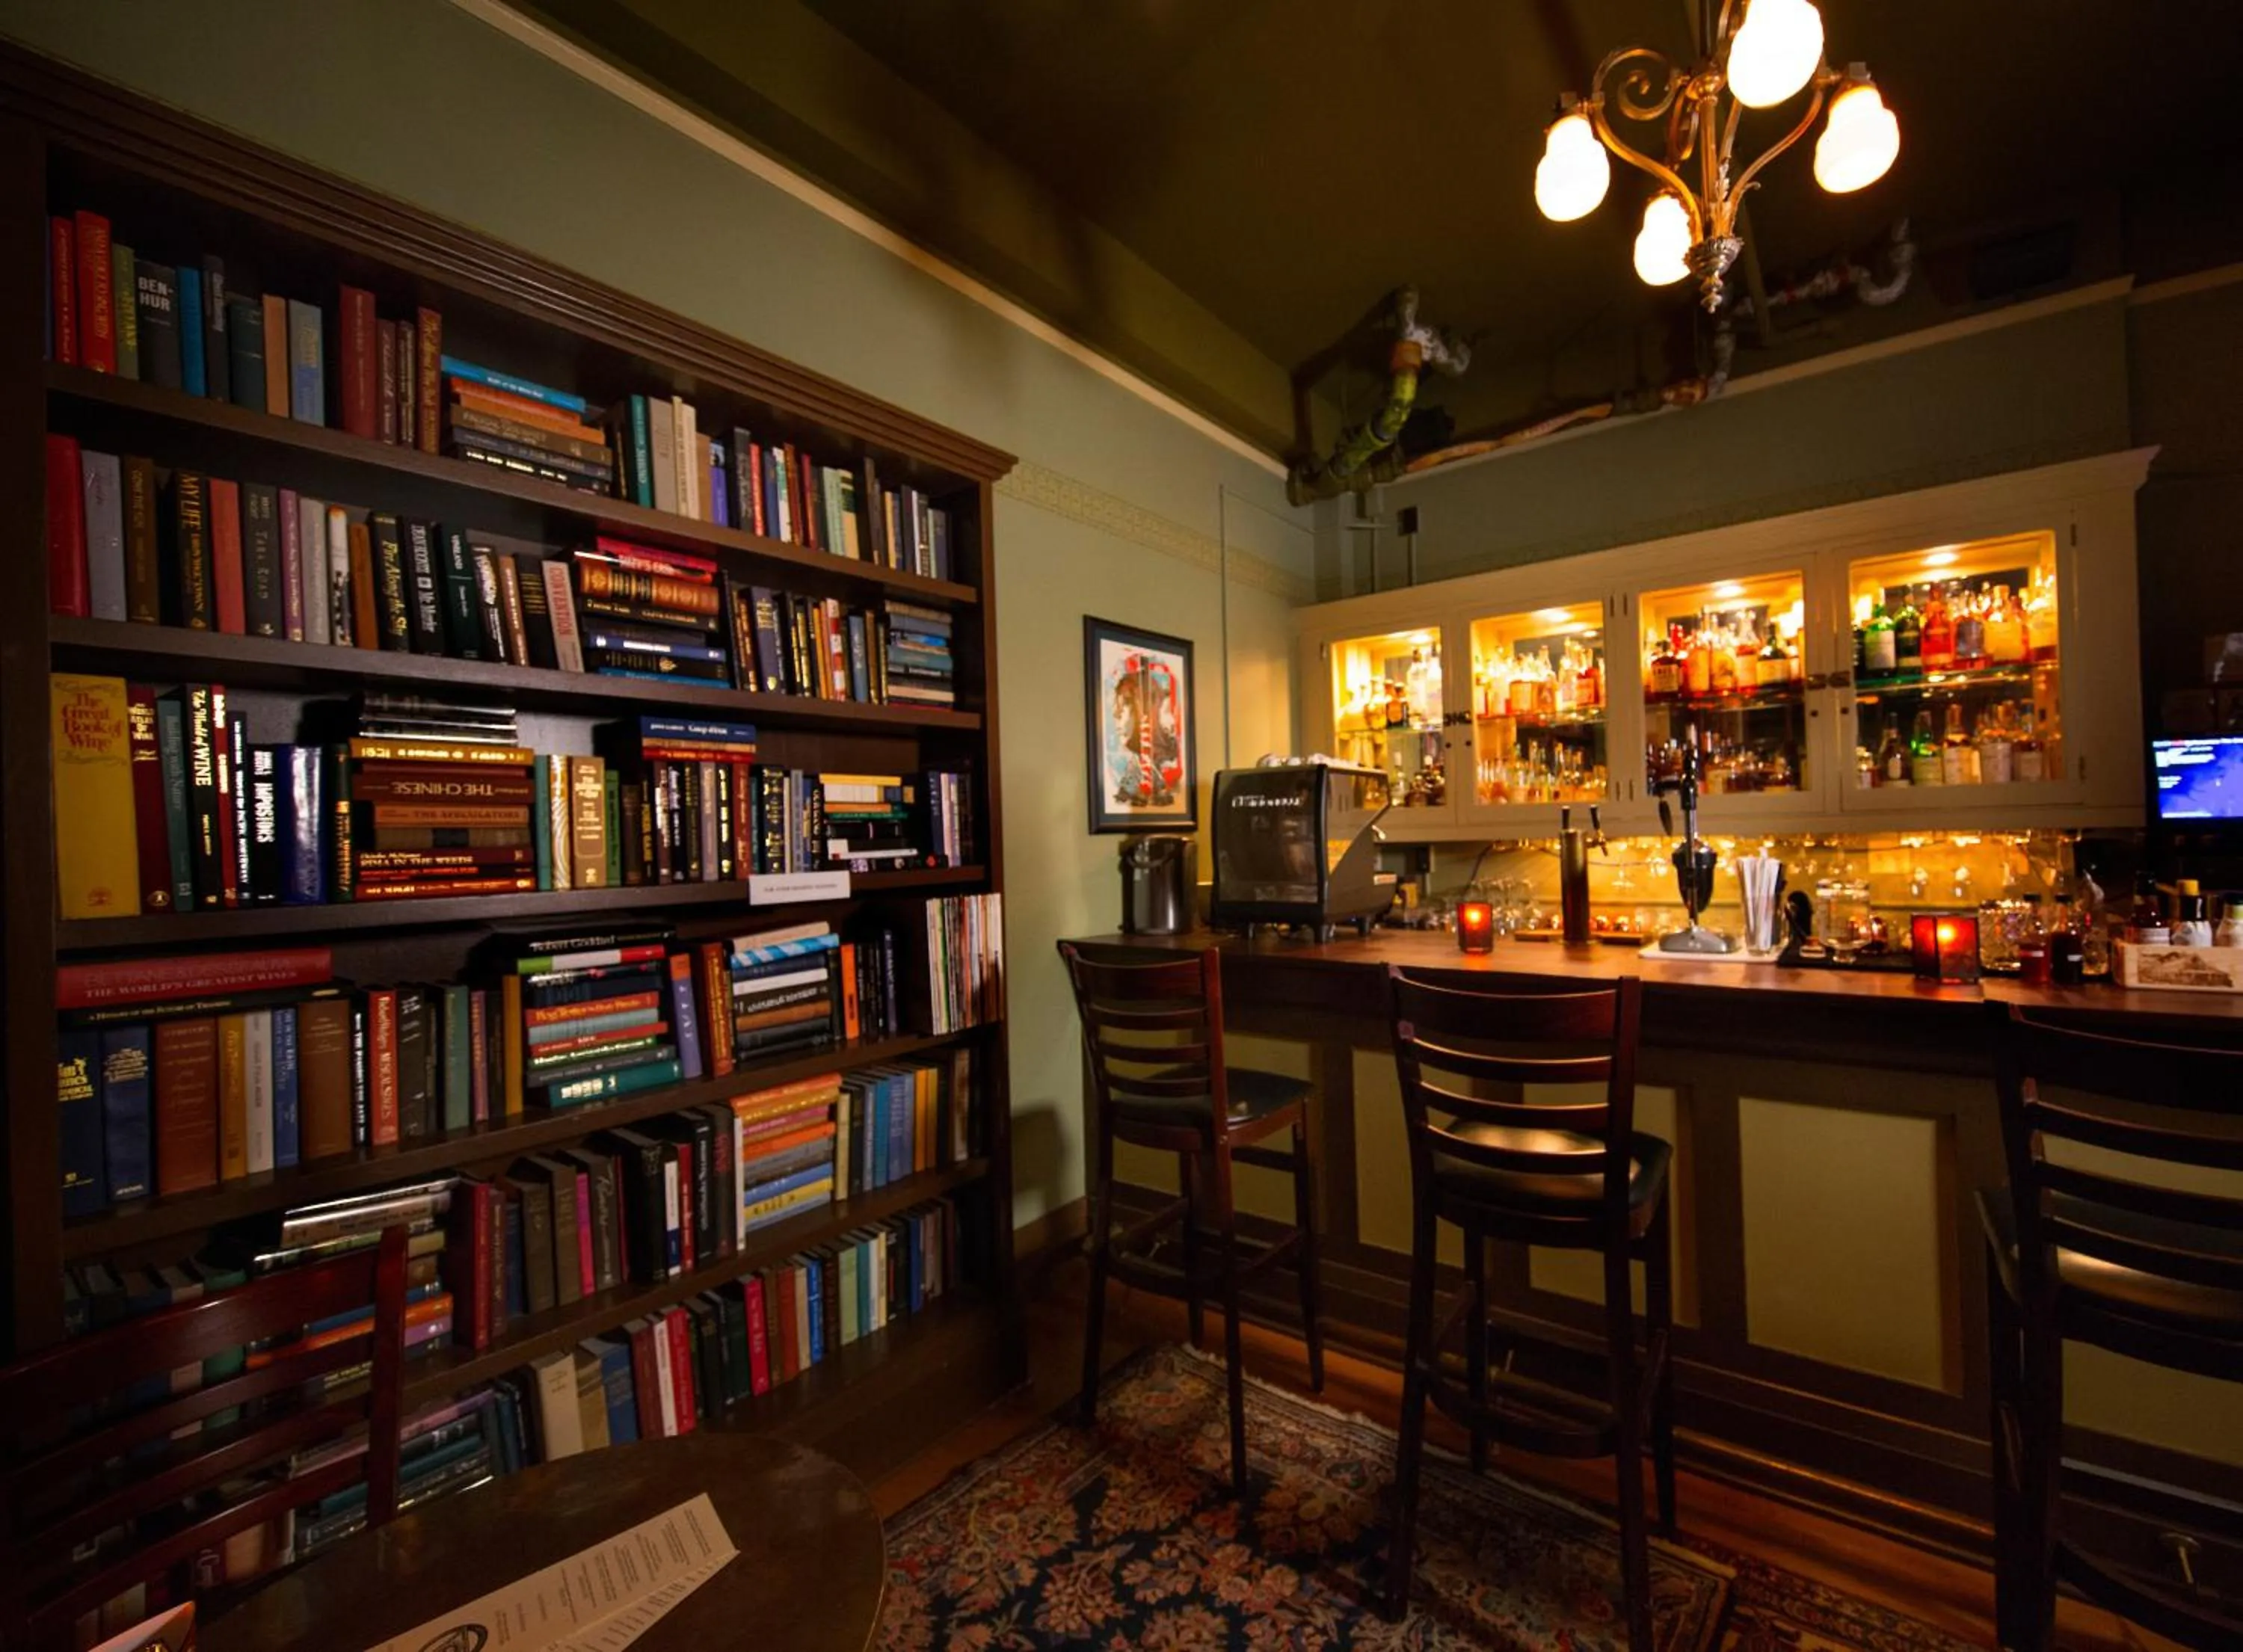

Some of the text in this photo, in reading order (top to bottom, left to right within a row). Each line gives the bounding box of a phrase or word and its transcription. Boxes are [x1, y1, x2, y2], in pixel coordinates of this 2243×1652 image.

[138, 277, 173, 295] BEN-
[138, 292, 171, 312] HUR
[179, 473, 200, 499] MY
[181, 499, 203, 531] LIFE
[382, 540, 407, 636] Fire Along the Sky
[549, 566, 574, 635] CONVENTION
[191, 688, 206, 708] The
[193, 748, 212, 786] WINE
[172, 779, 185, 811] Nature
[390, 781, 494, 797] THE CHINESE
[253, 782, 276, 843] IMPOSTORS
[84, 987, 117, 999] THE
[119, 981, 182, 996] WORLD'S
[184, 976, 253, 991] GREATEST
